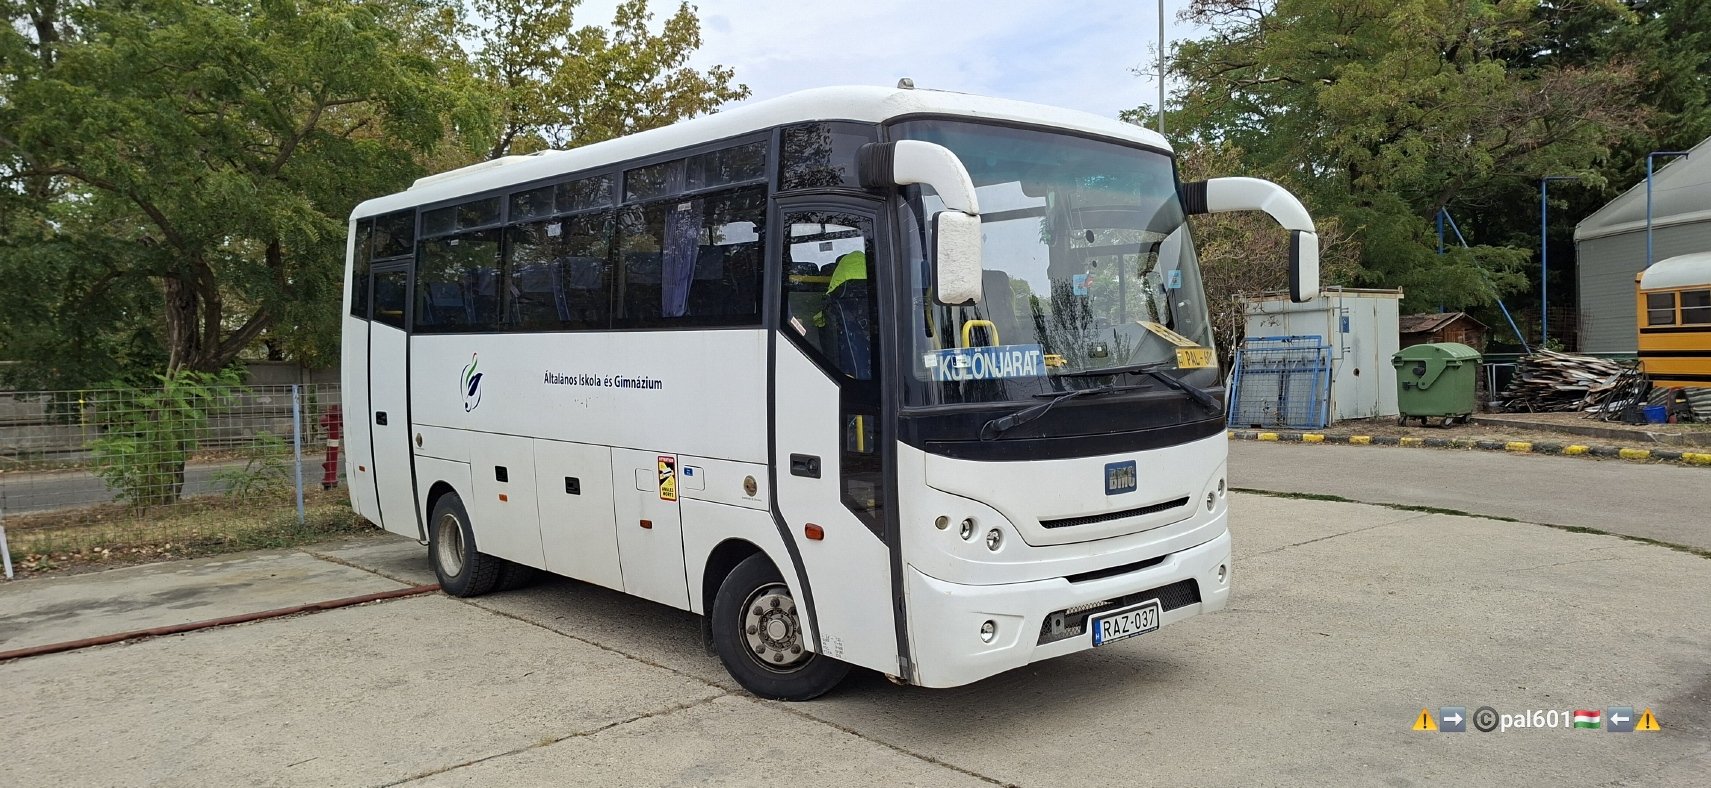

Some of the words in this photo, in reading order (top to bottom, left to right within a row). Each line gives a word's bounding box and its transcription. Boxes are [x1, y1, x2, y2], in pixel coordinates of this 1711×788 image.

[939, 346, 1040, 381] KÜLÖNJÁRAT
[543, 369, 578, 386] Általános
[578, 373, 601, 387] Iskola
[603, 375, 613, 388] és
[614, 375, 663, 390] Gimnázium
[1108, 465, 1136, 490] BMC
[1103, 608, 1155, 639] RAZ-037
